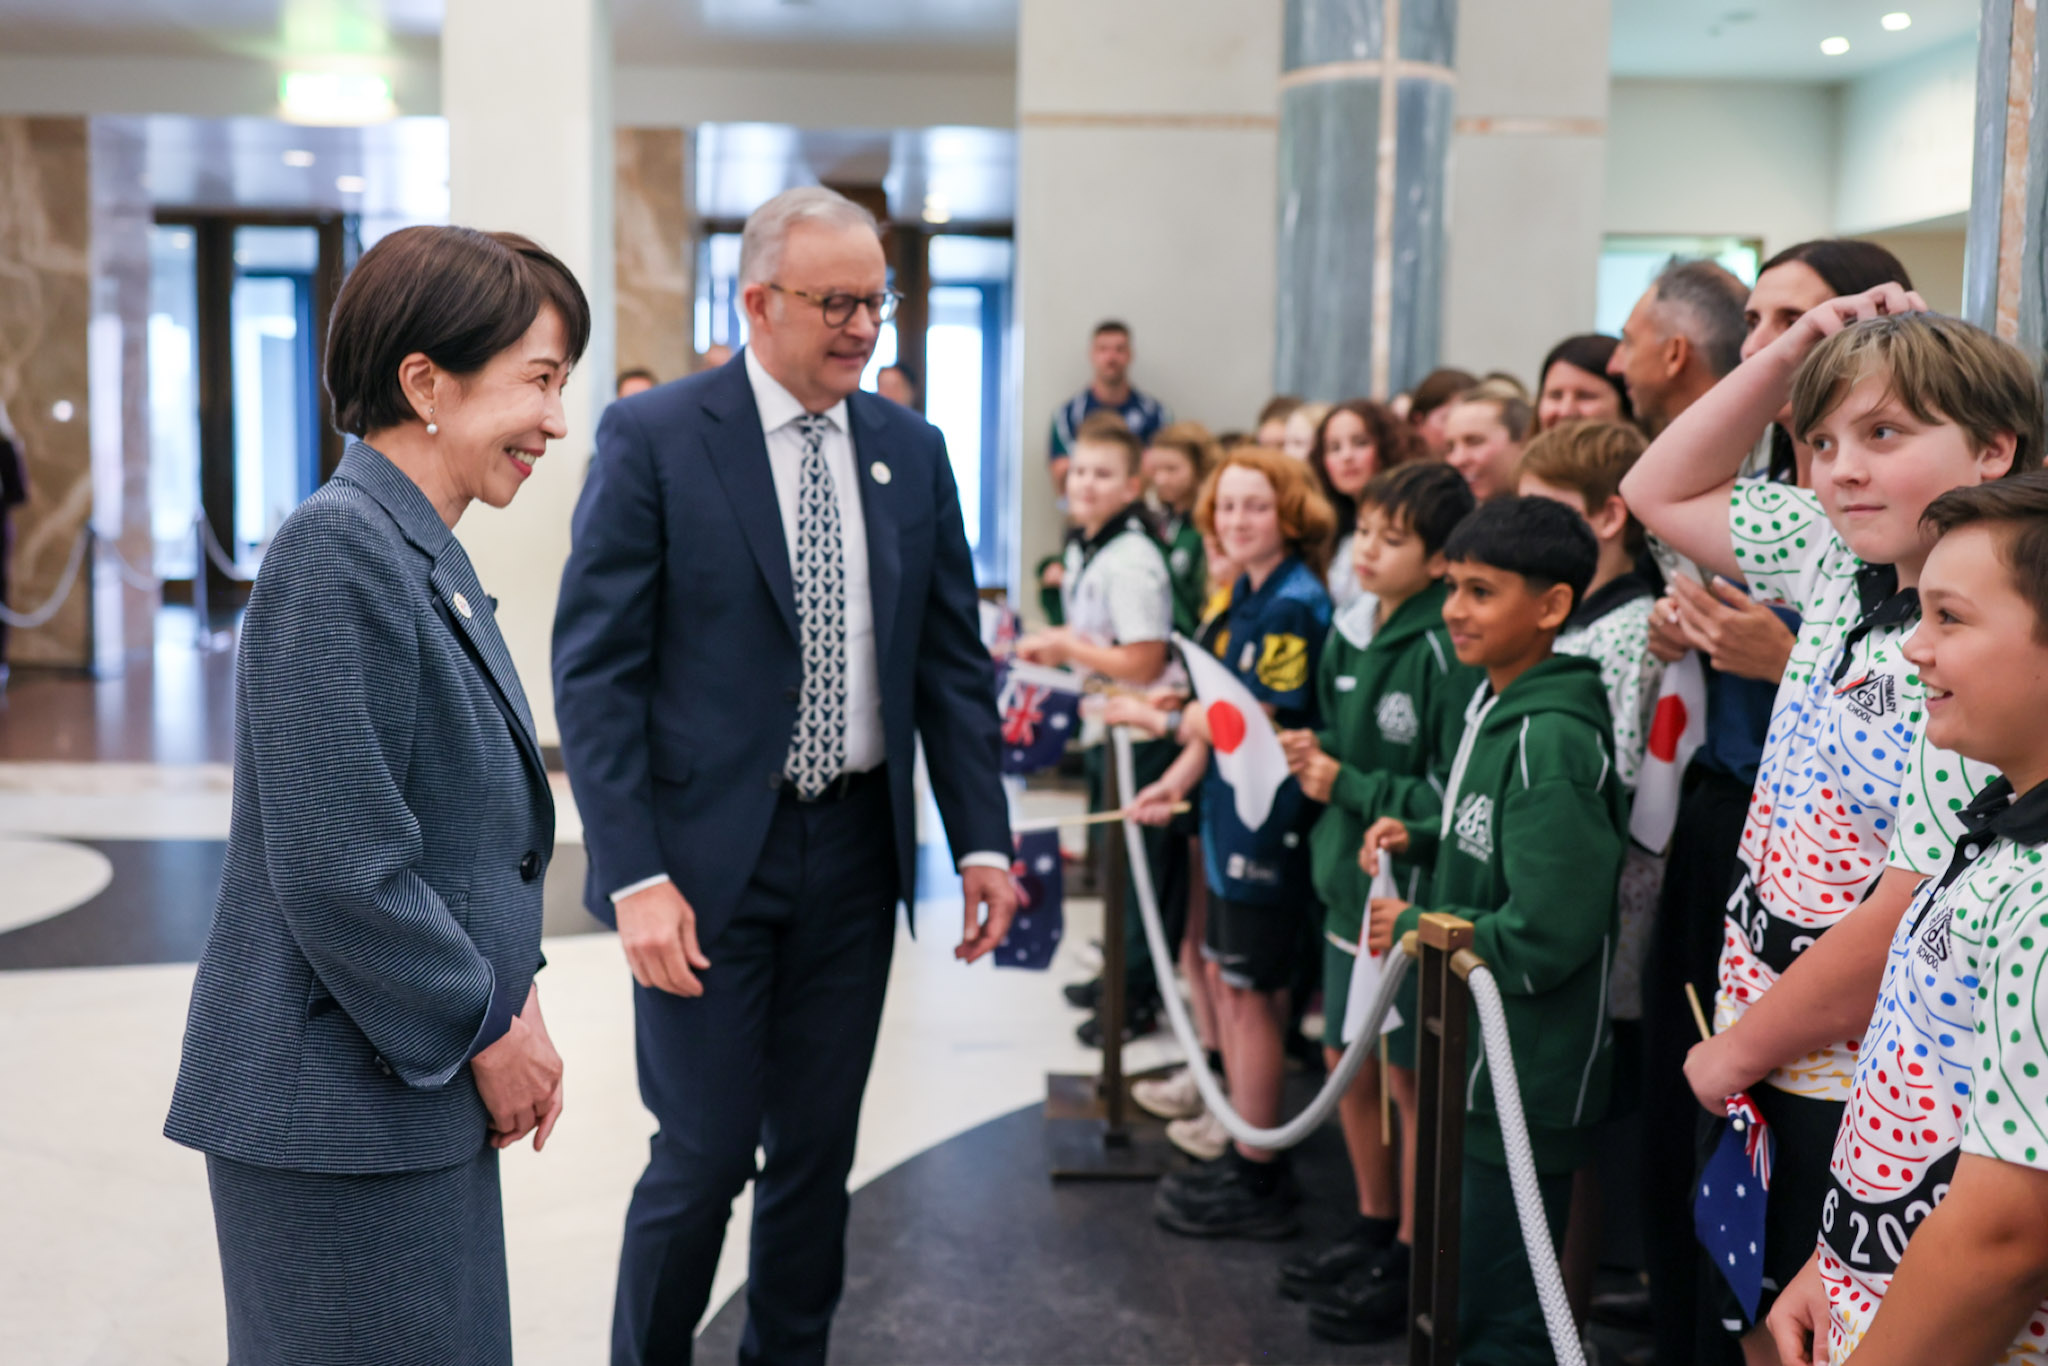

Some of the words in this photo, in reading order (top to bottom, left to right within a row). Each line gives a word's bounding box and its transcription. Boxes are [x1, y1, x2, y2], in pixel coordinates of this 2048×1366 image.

[1846, 702, 1872, 724] SCHOOL
[1886, 675, 1897, 713] PRIMARY
[1749, 909, 1768, 953] 6
[1916, 944, 1939, 973] SCHOO
[1822, 1187, 1839, 1233] 6
